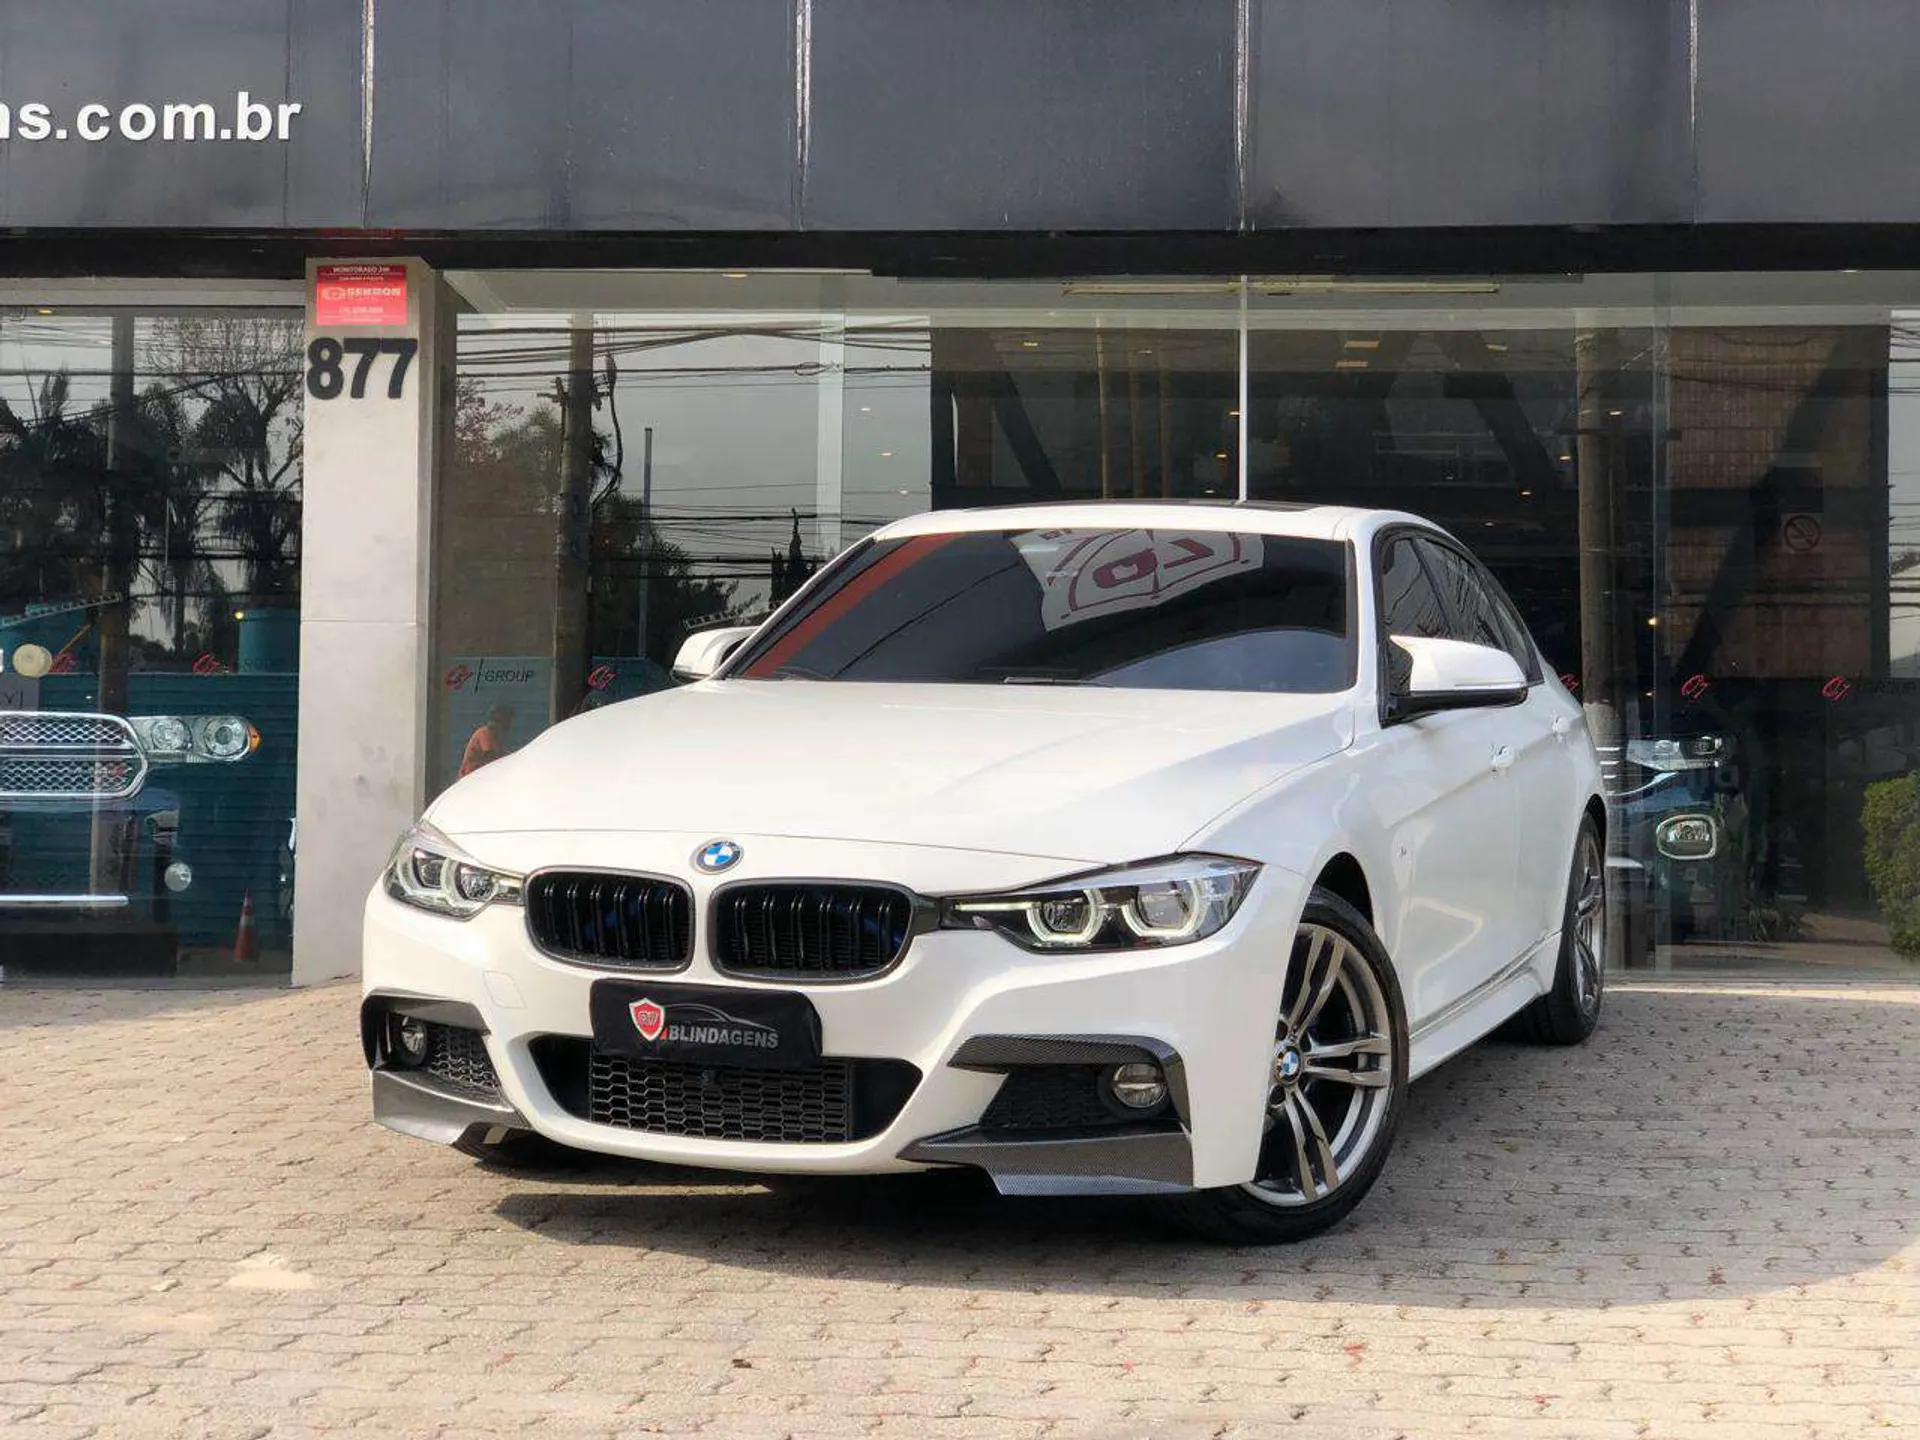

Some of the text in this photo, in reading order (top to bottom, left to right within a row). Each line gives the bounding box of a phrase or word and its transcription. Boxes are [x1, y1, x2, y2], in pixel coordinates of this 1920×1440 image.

[307, 337, 418, 400] 877
[484, 669, 534, 682] GROUP
[669, 1023, 780, 1049] BLINDAGENS
